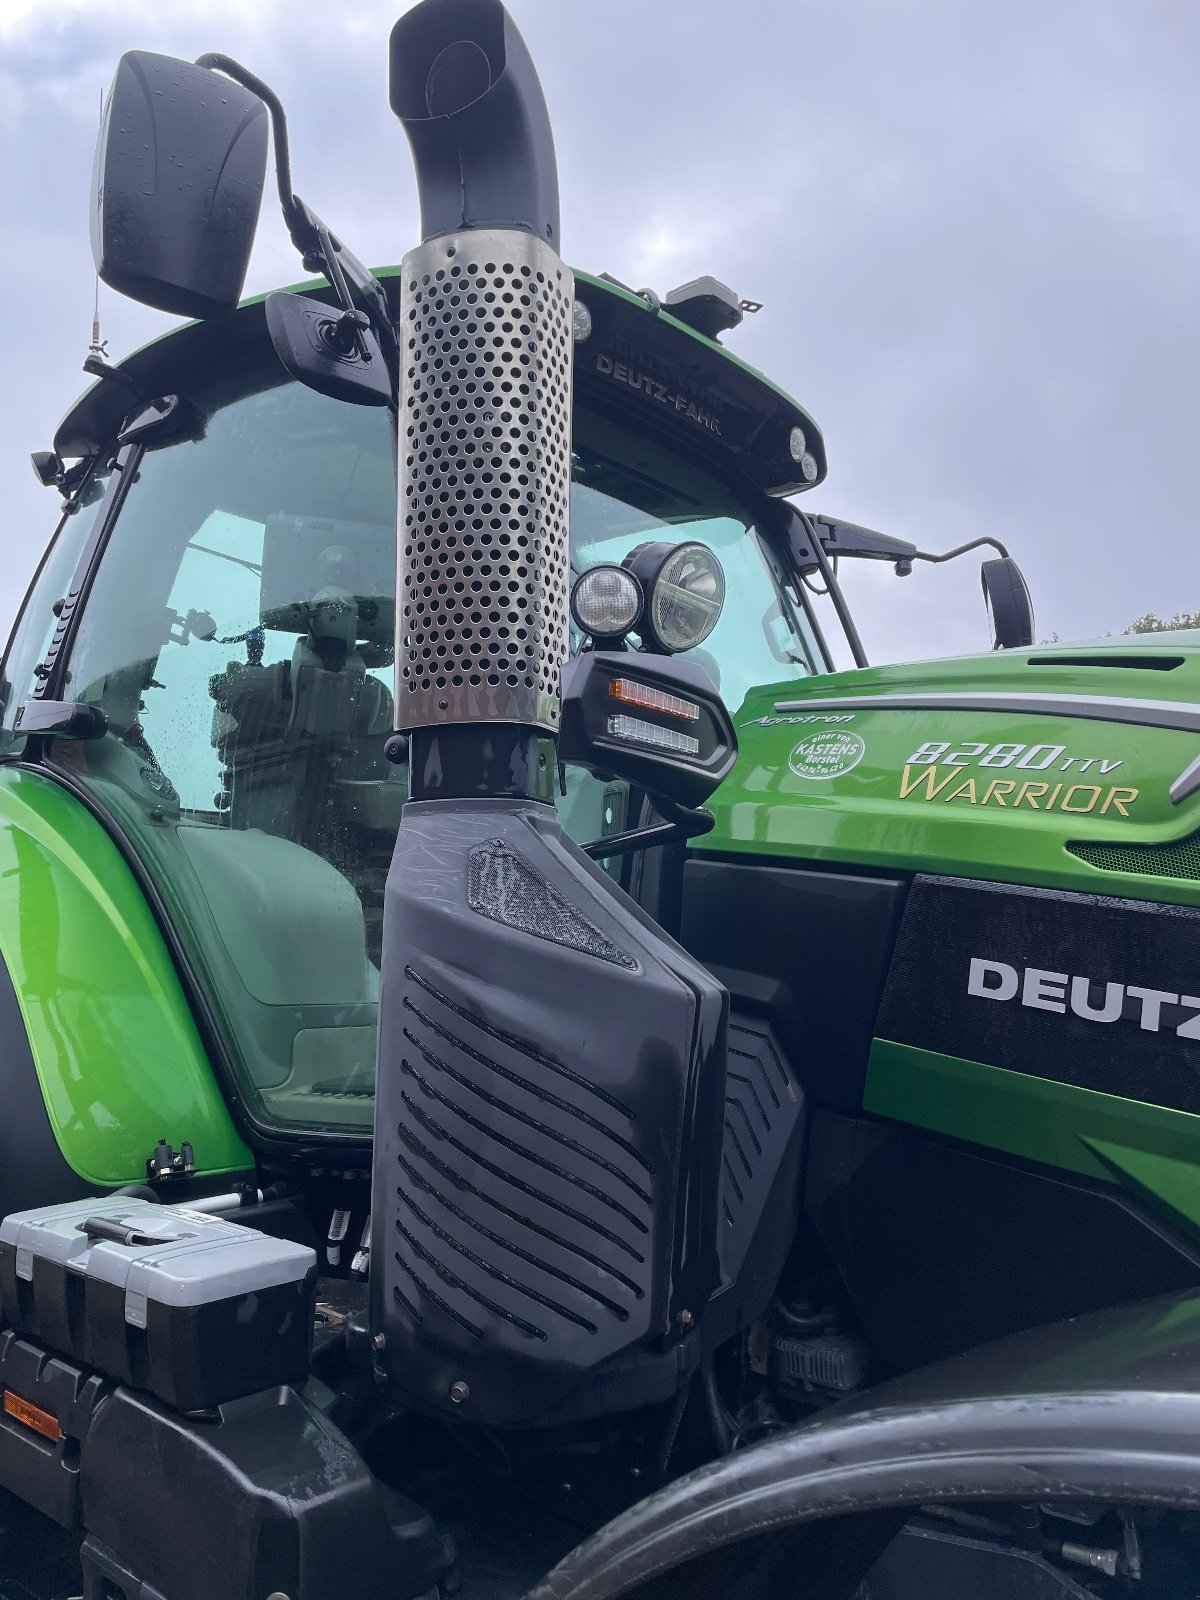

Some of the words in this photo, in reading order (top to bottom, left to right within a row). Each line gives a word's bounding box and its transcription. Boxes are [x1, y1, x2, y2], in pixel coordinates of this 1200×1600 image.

[596, 353, 721, 436] DEUTZ-FAHR
[740, 715, 856, 728] Agrotron
[812, 734, 836, 743] einer
[837, 734, 851, 743] von
[795, 743, 860, 755] KASTENS
[805, 755, 840, 764] Borstel
[906, 742, 1066, 770] 8280
[1059, 757, 1125, 774] TTV
[899, 764, 1139, 817] WARRIOR
